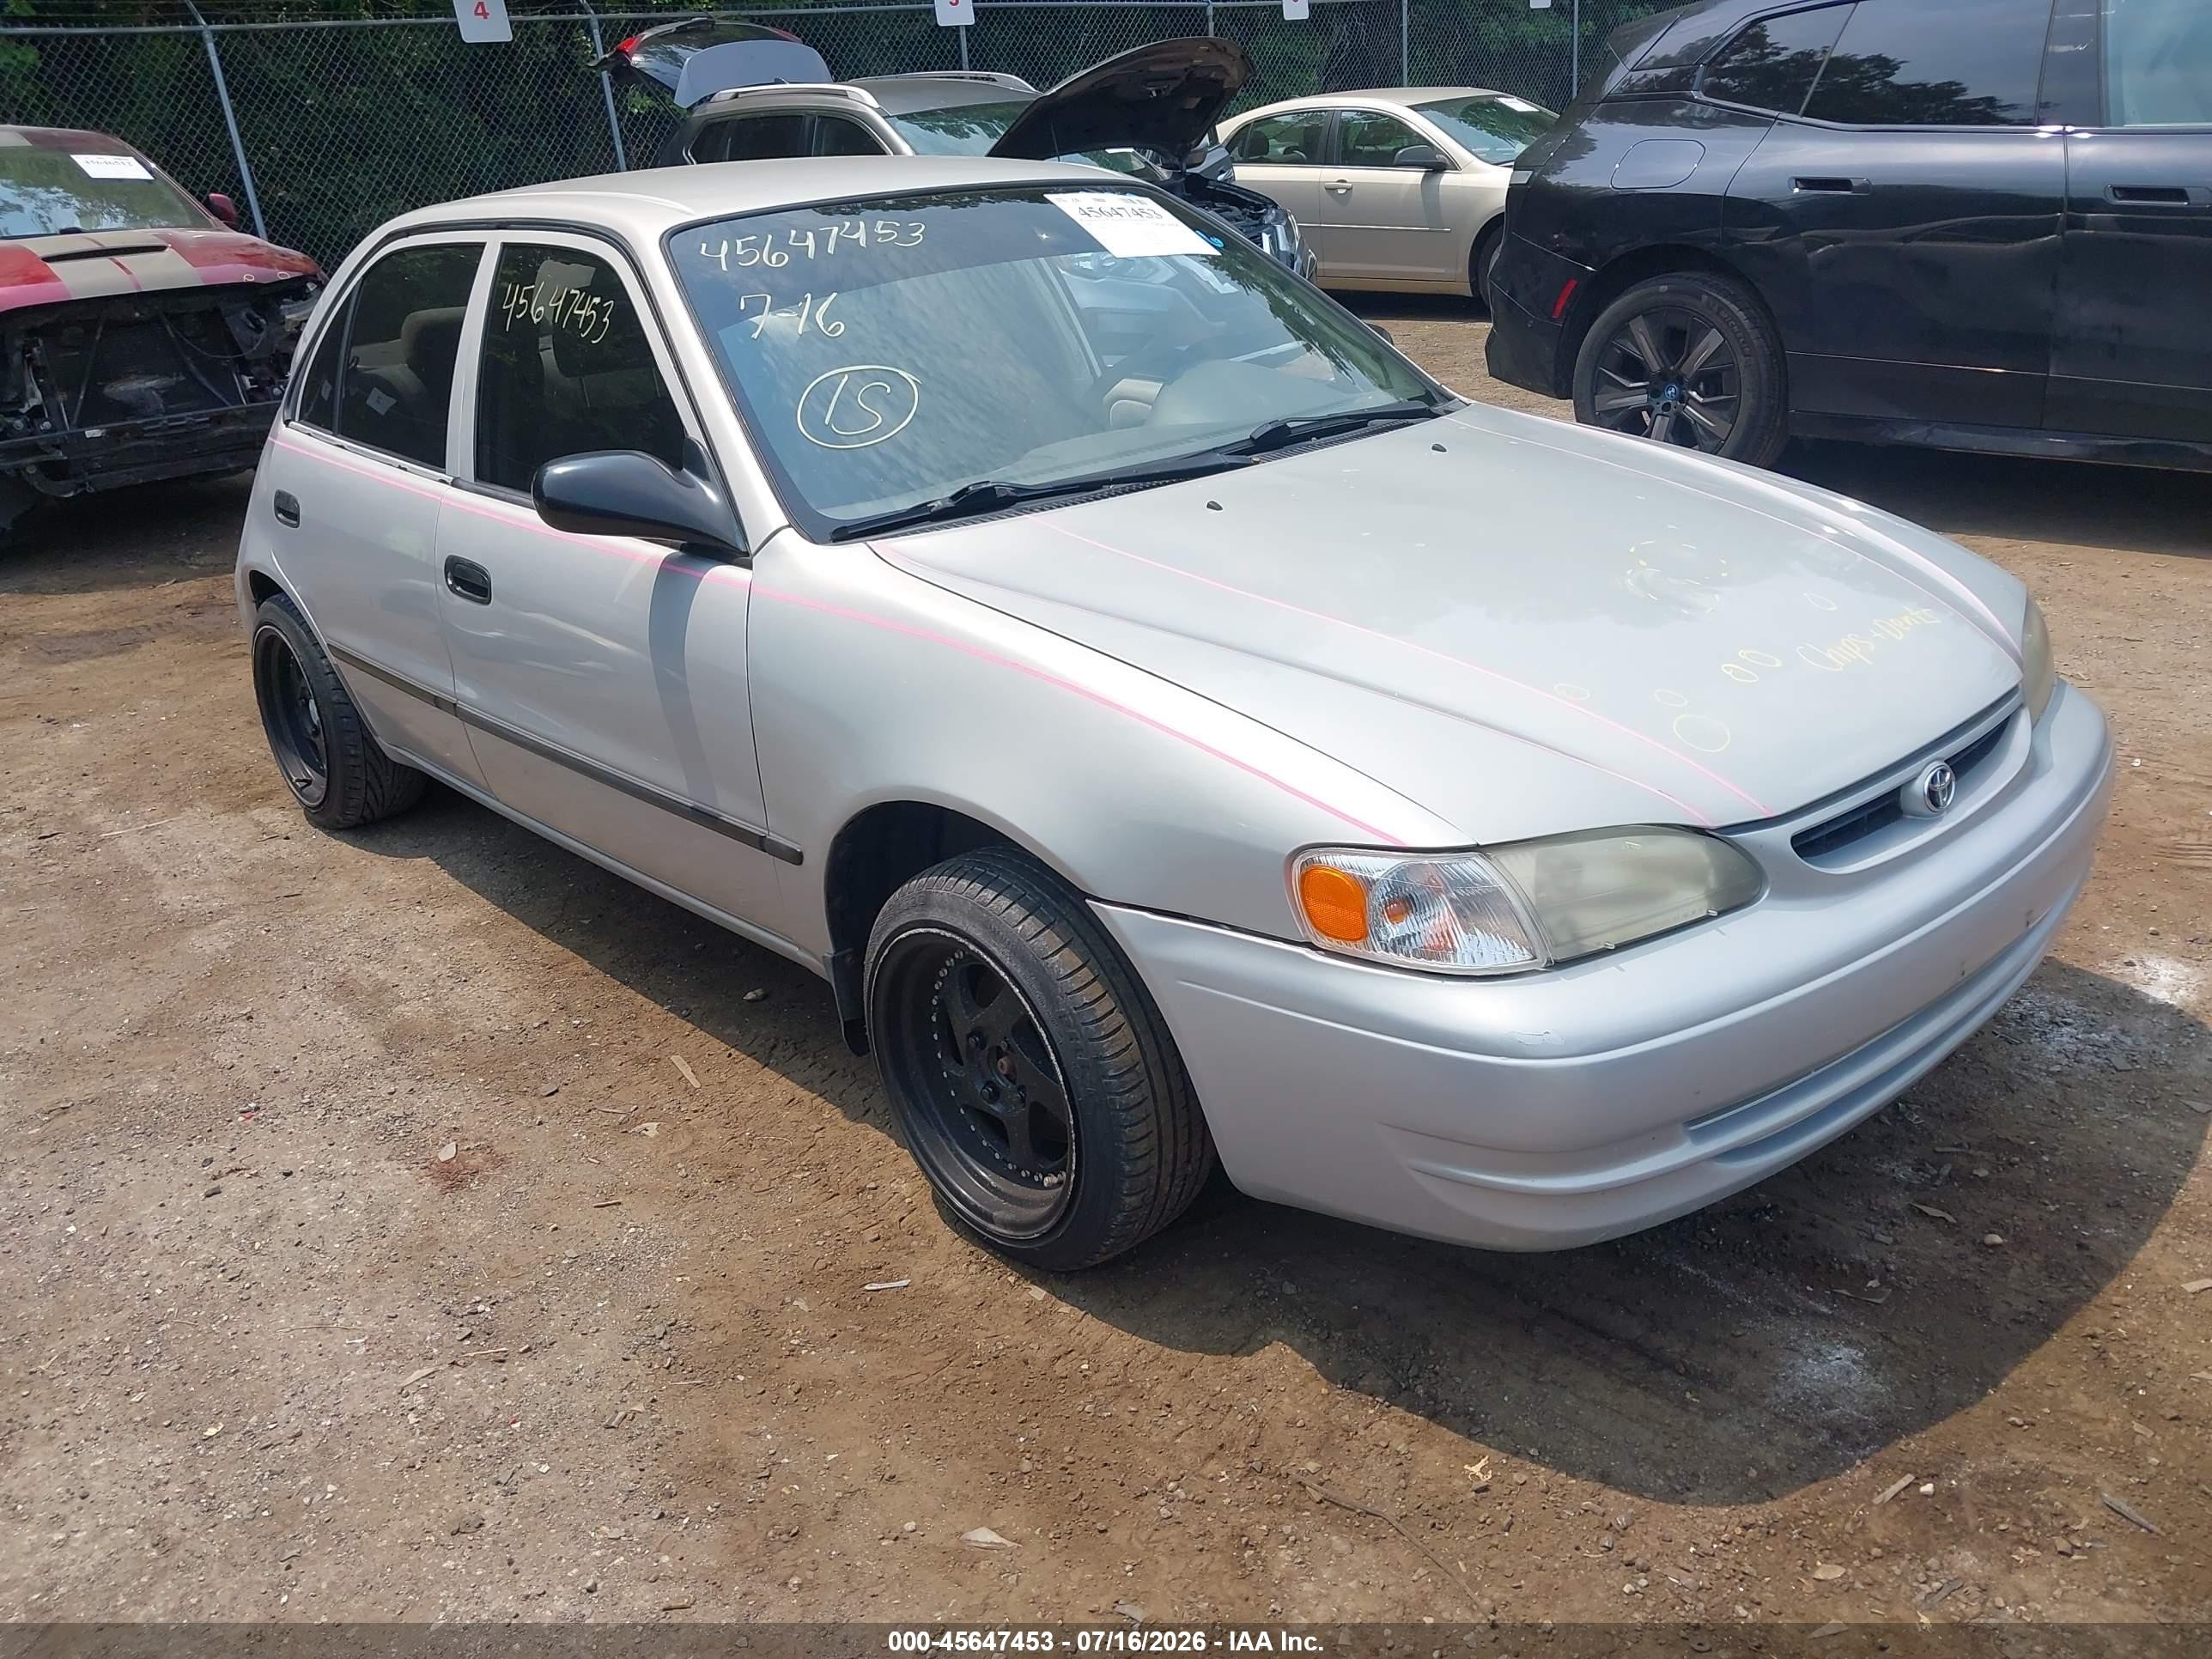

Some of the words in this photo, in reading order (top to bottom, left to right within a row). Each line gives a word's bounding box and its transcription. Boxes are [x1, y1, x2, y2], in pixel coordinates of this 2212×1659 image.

[474, 2, 489, 19] 4
[1078, 205, 1164, 221] 45647453
[700, 221, 927, 271] 45647453
[502, 281, 615, 343] 45647453
[739, 292, 846, 340] 7-16
